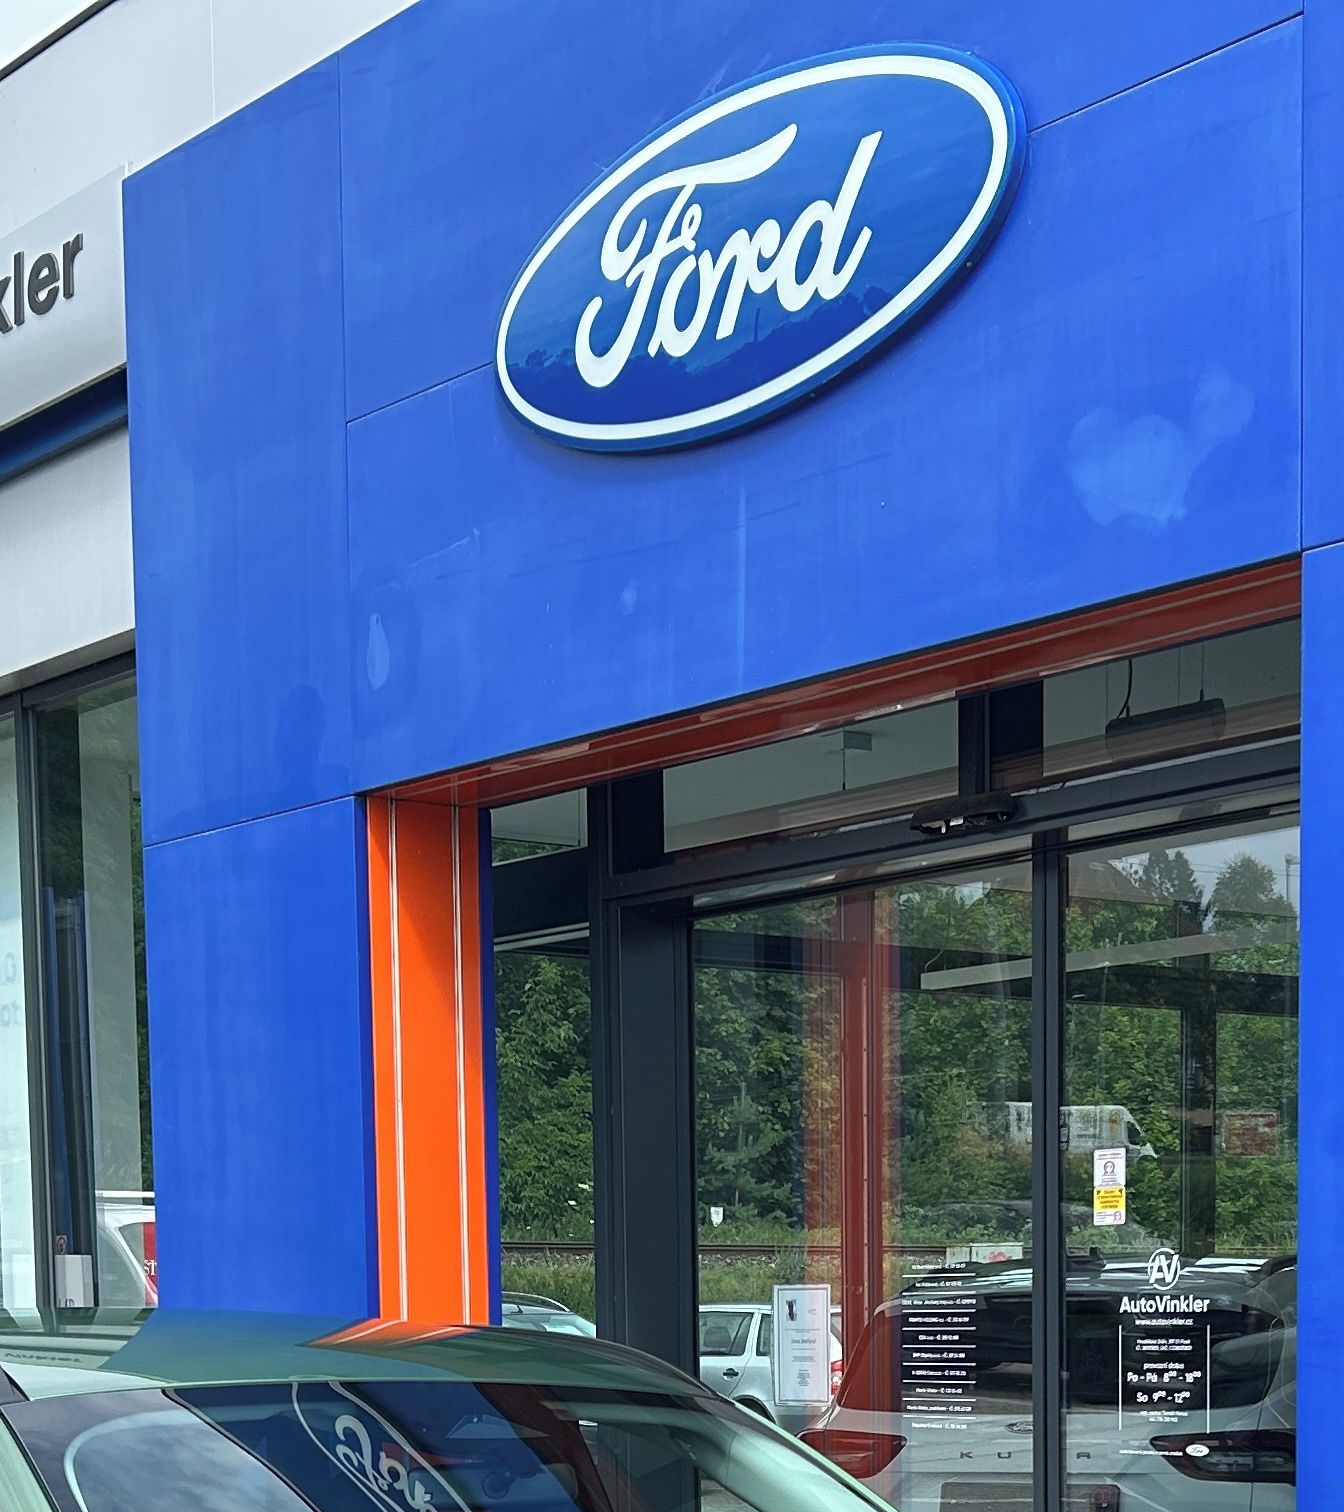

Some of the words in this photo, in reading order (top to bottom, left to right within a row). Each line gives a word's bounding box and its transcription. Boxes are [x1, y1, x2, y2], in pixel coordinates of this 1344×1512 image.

[574, 123, 884, 388] Ford
[1119, 1294, 1211, 1314] AutoVinkler
[959, 1451, 1092, 1460] KUA
